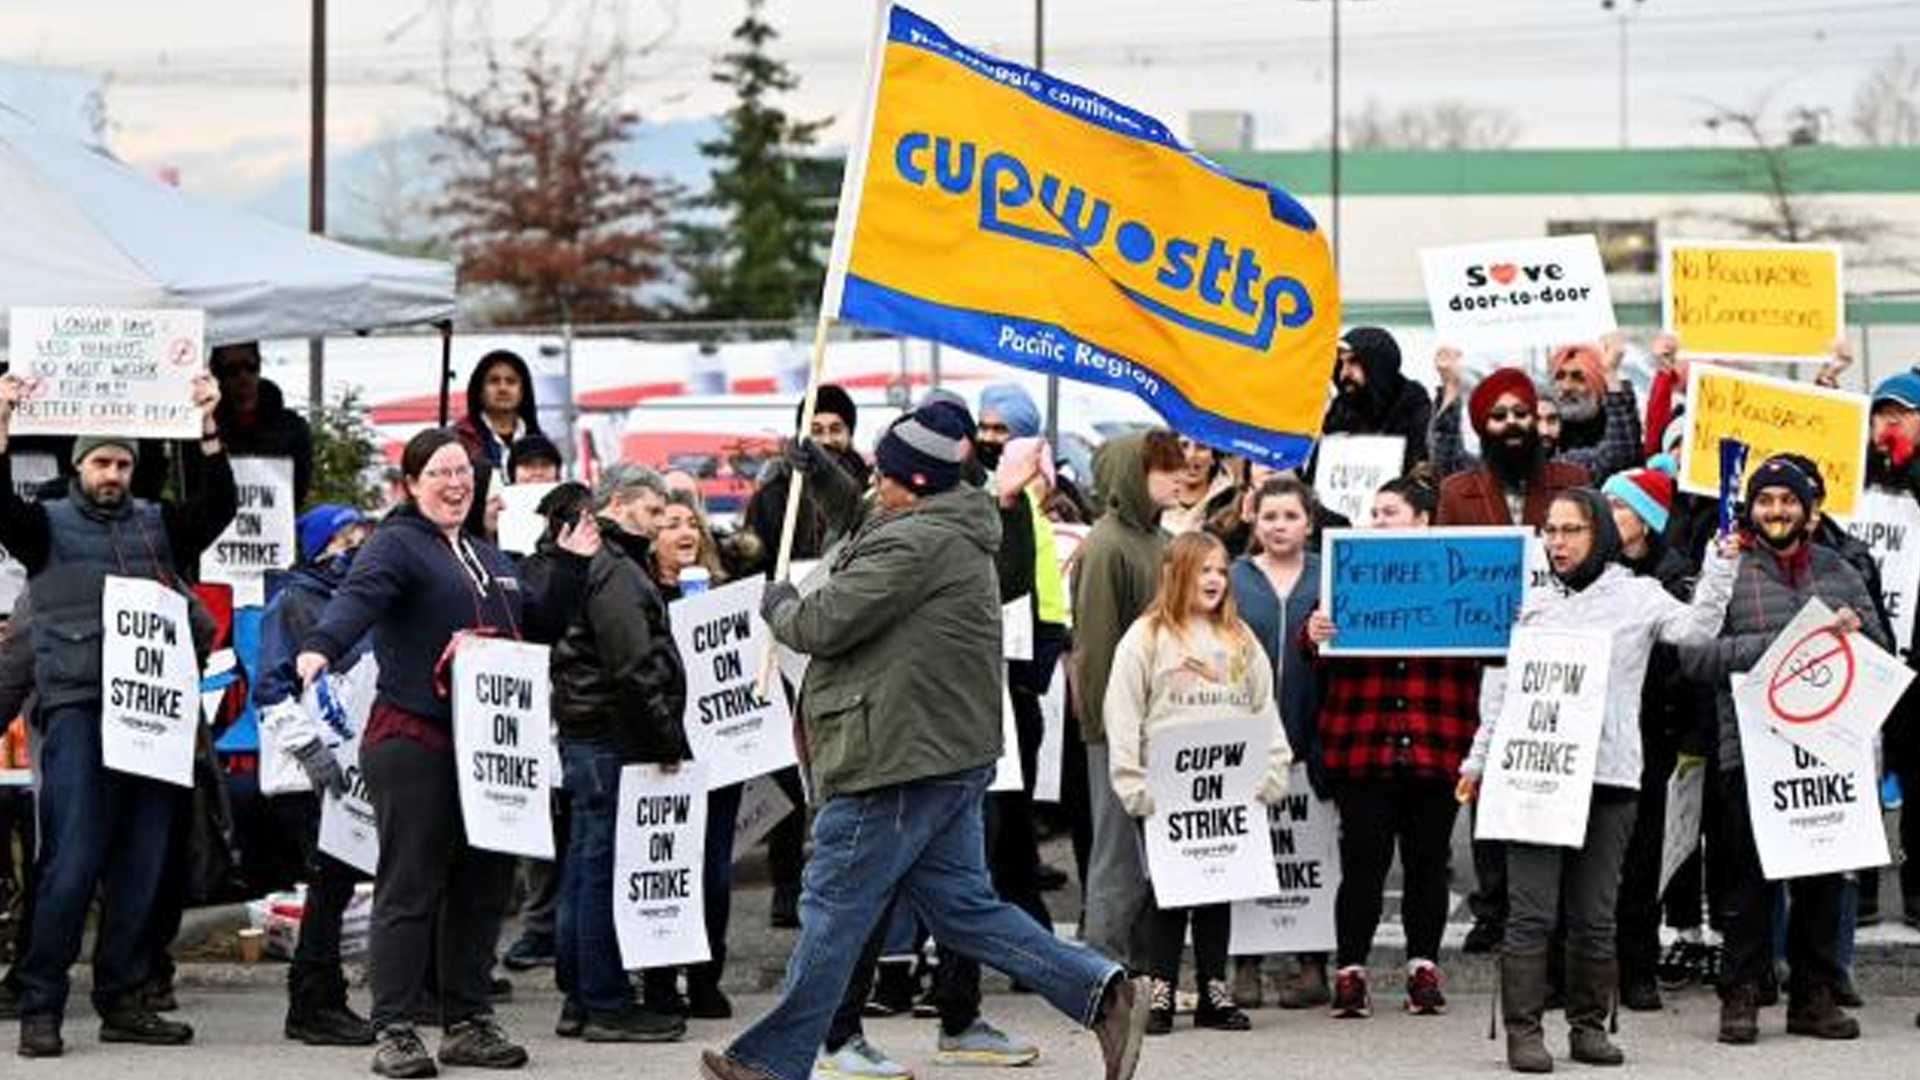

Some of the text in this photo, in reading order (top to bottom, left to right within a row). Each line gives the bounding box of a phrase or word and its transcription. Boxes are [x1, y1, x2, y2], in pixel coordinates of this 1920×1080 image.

[1449, 287, 1591, 311] door-to-door
[998, 324, 1160, 397] Pacific Region
[17, 400, 82, 418] BETTER
[236, 512, 262, 537] ON
[216, 542, 280, 566] STRIKE
[116, 610, 178, 646] CUPW
[693, 610, 751, 653] CUPW
[135, 646, 164, 678] ON
[713, 649, 742, 683] ON
[1521, 660, 1588, 696] CUPW
[111, 677, 184, 720] STRIKE
[475, 672, 533, 710] CUPW
[492, 713, 519, 748] ON
[1528, 699, 1561, 733] ON
[472, 750, 539, 790] STRIKE
[1174, 740, 1248, 773] CUPW
[1501, 738, 1580, 776] STRIKE
[1192, 774, 1224, 803] ON
[1773, 770, 1858, 811] STRIKE
[637, 793, 691, 827] CUPW
[1168, 804, 1249, 842] STRIKE
[649, 831, 676, 863] ON
[627, 867, 692, 902] STRIKE
